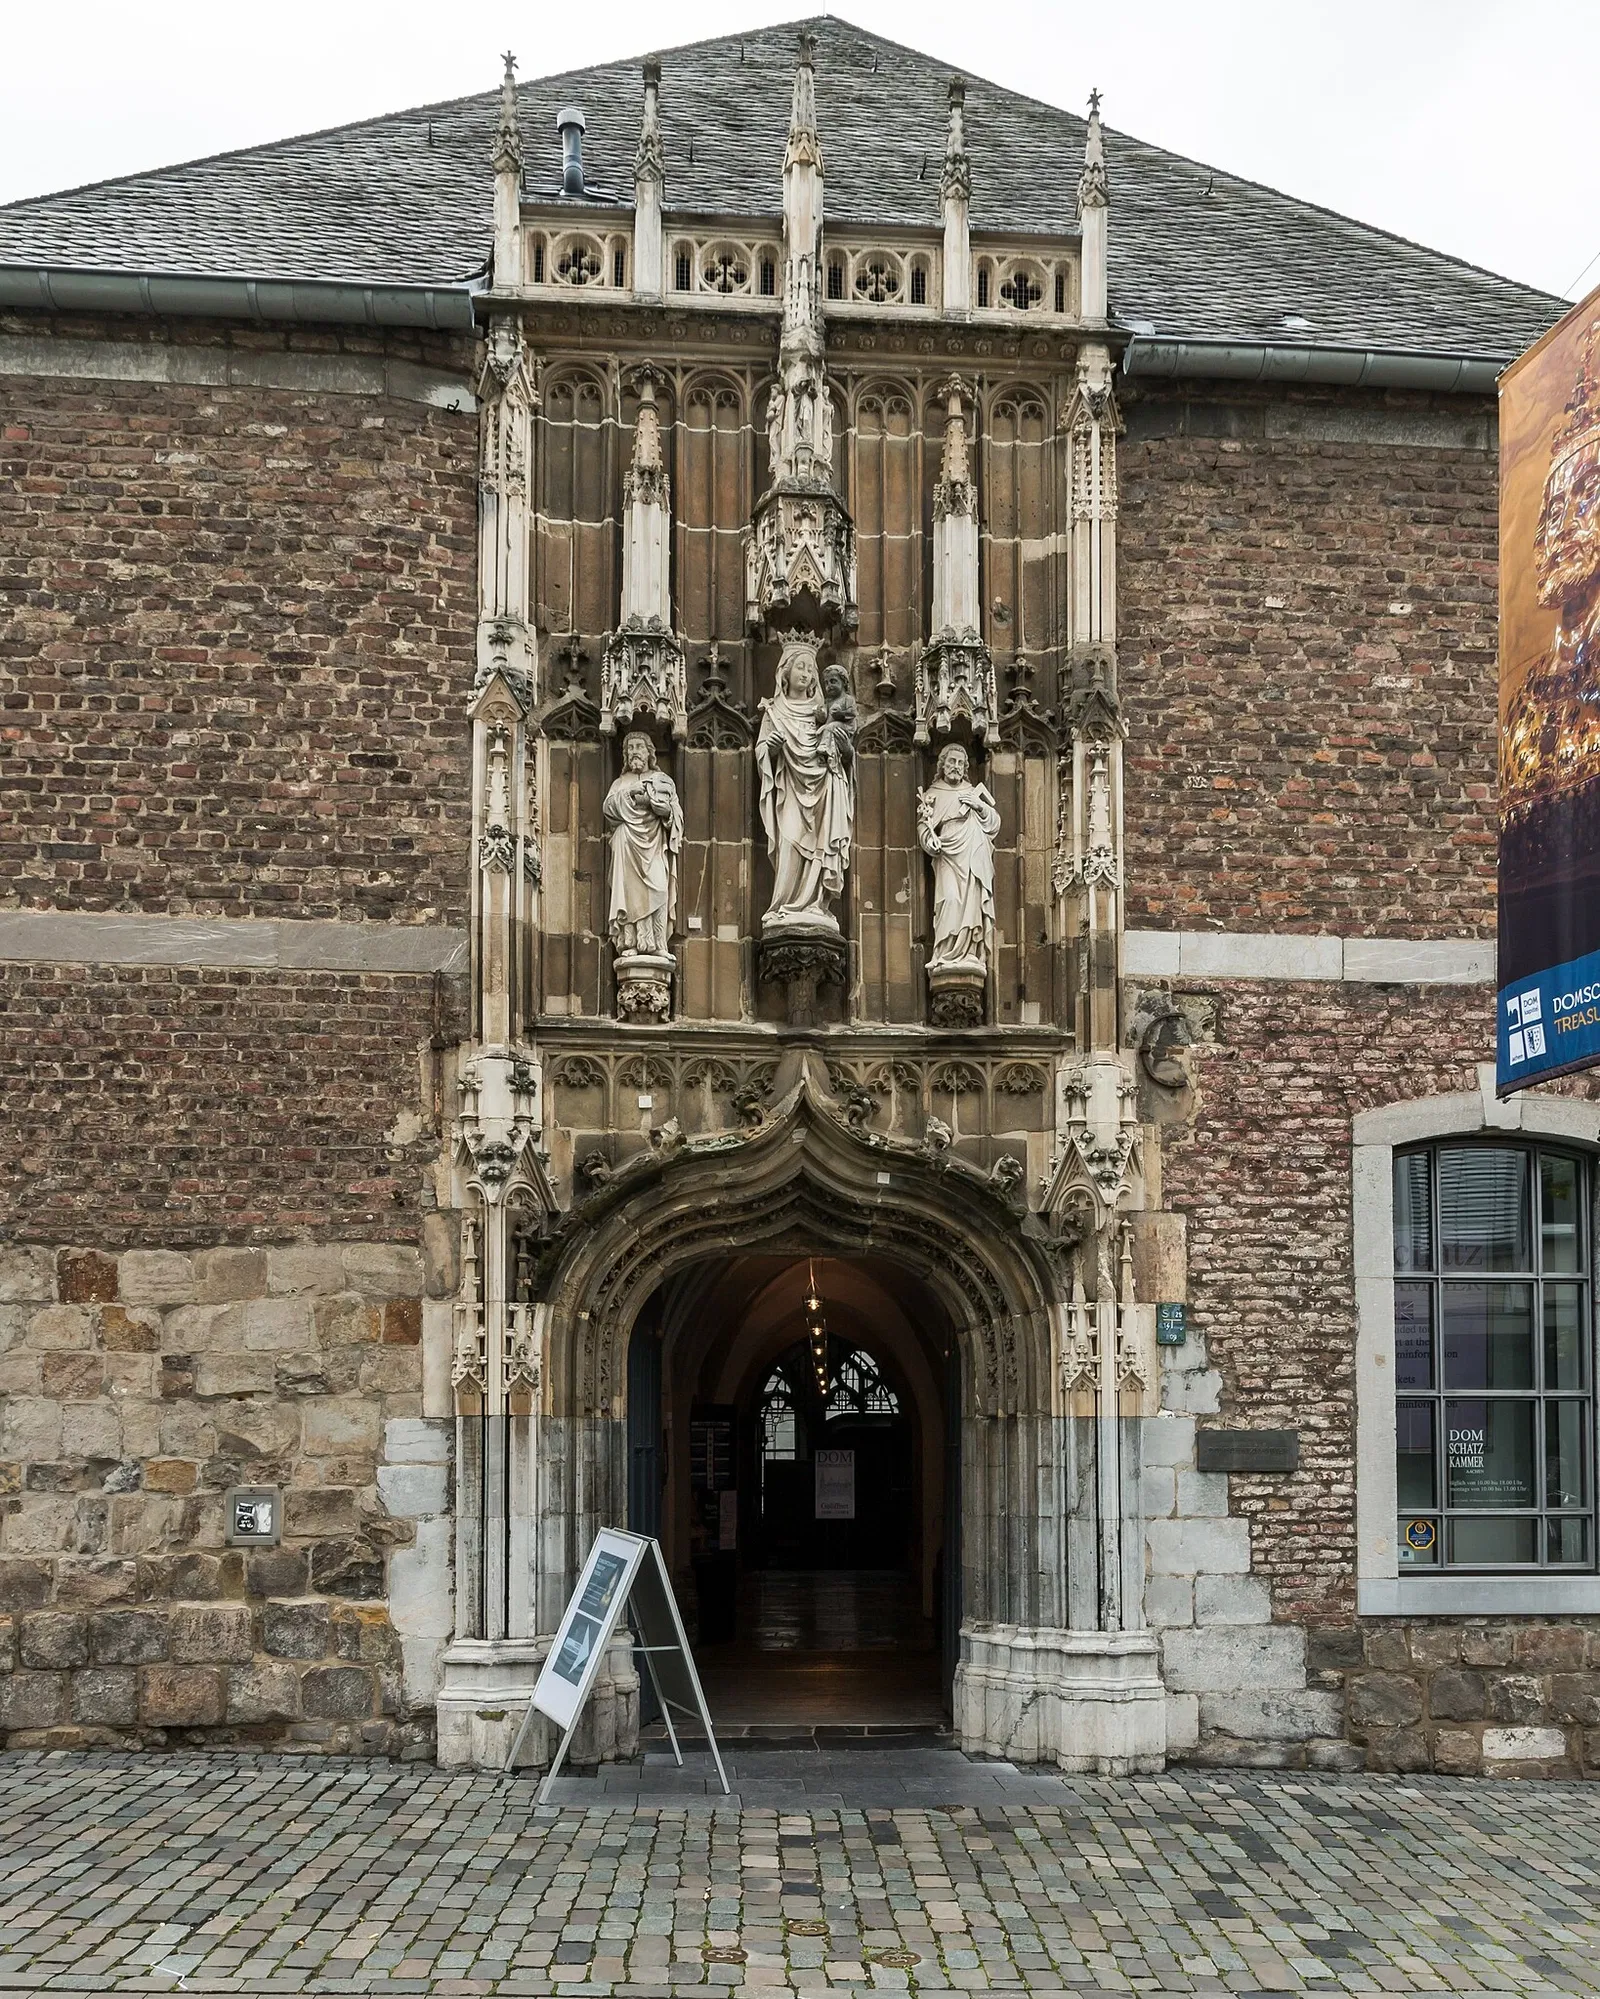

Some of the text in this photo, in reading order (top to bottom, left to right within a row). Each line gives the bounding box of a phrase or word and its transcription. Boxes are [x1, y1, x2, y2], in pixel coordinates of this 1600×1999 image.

[1523, 997, 1538, 1008] DOM
[1449, 1429, 1484, 1441] DOM
[1449, 1443, 1484, 1454] SCHATZ
[818, 1451, 852, 1462] DOM
[1449, 1456, 1484, 1468] KAMMER
